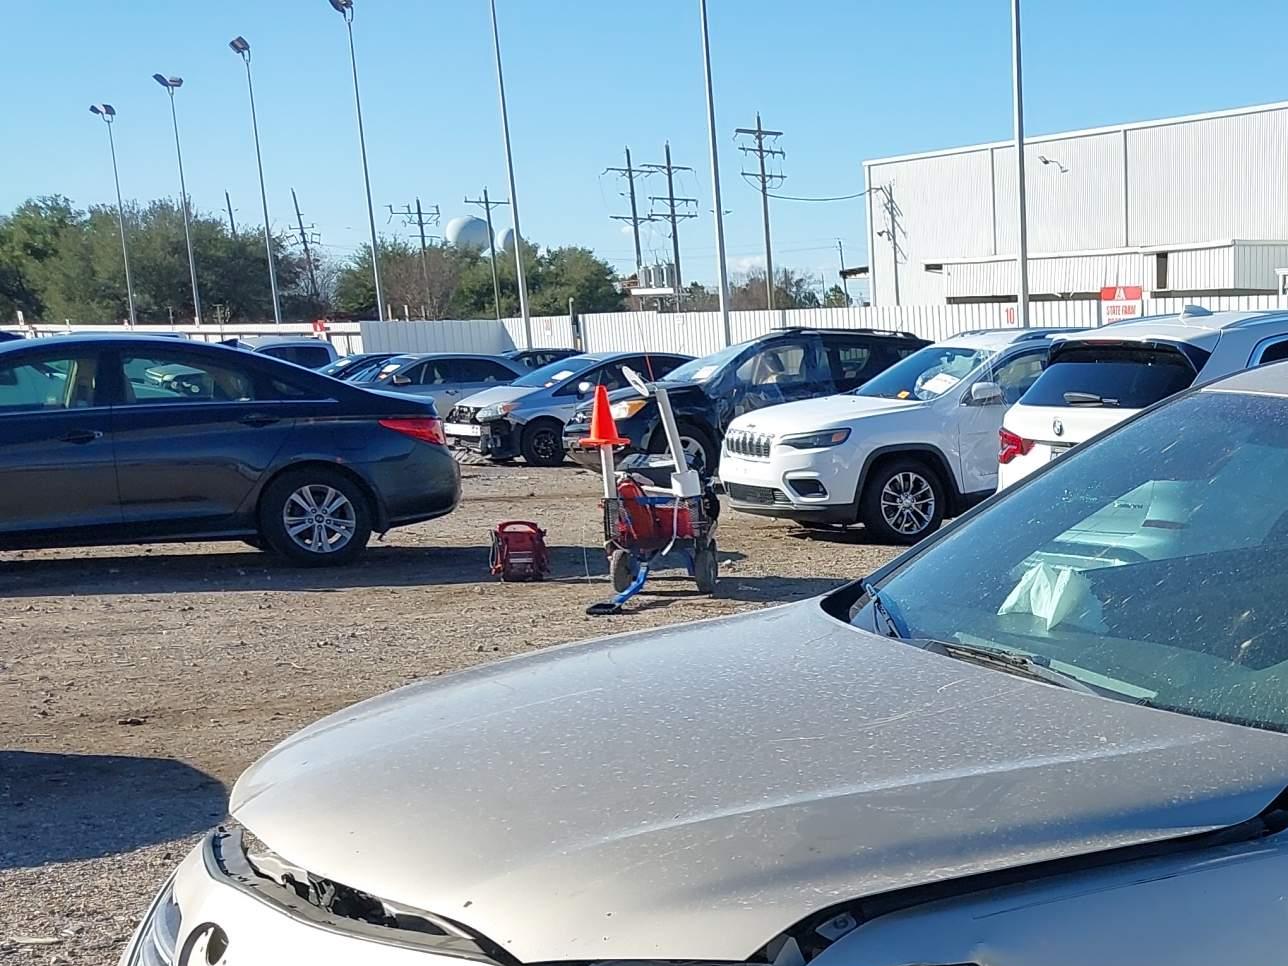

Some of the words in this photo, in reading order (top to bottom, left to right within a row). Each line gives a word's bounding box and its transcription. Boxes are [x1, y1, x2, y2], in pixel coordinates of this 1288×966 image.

[1005, 306, 1015, 326] 10
[1106, 305, 1121, 316] STATE
[1122, 304, 1137, 315] FARM
